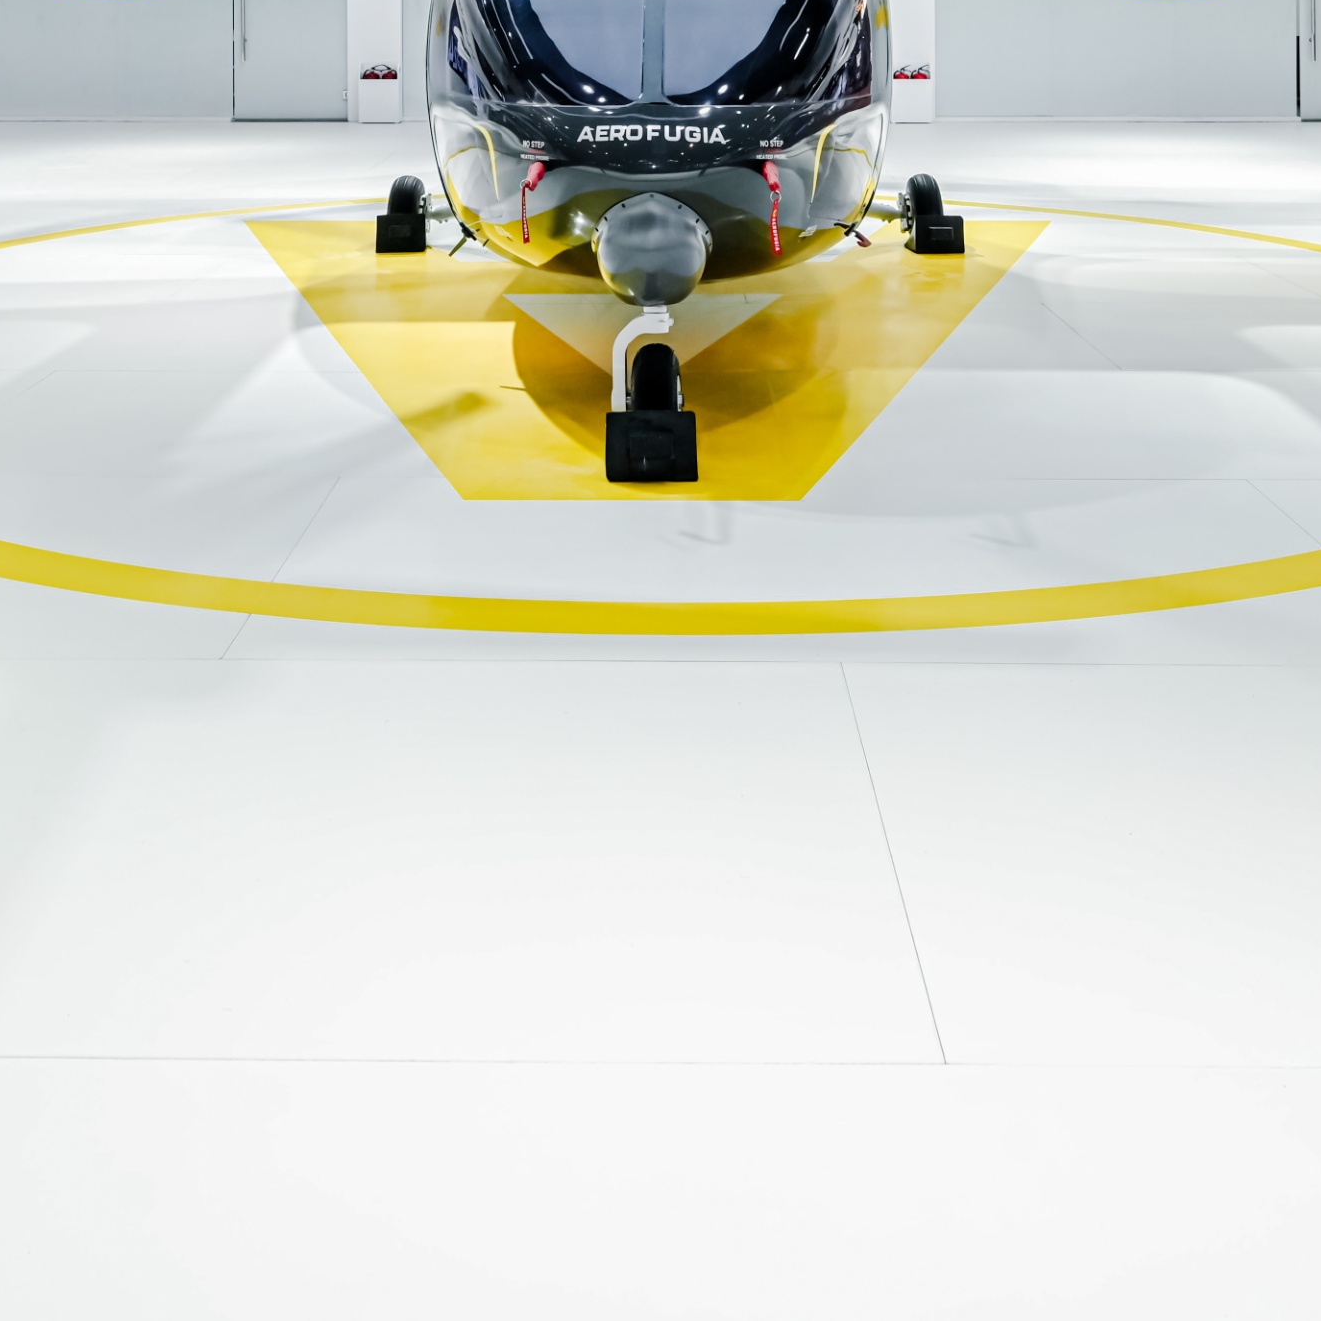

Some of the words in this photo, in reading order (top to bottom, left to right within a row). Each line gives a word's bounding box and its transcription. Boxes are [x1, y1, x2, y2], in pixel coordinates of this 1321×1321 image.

[576, 124, 728, 145] AEROFUGIA
[522, 139, 531, 148] NO
[531, 140, 545, 149] STEP
[759, 139, 769, 148] NO
[769, 139, 784, 148] STEP
